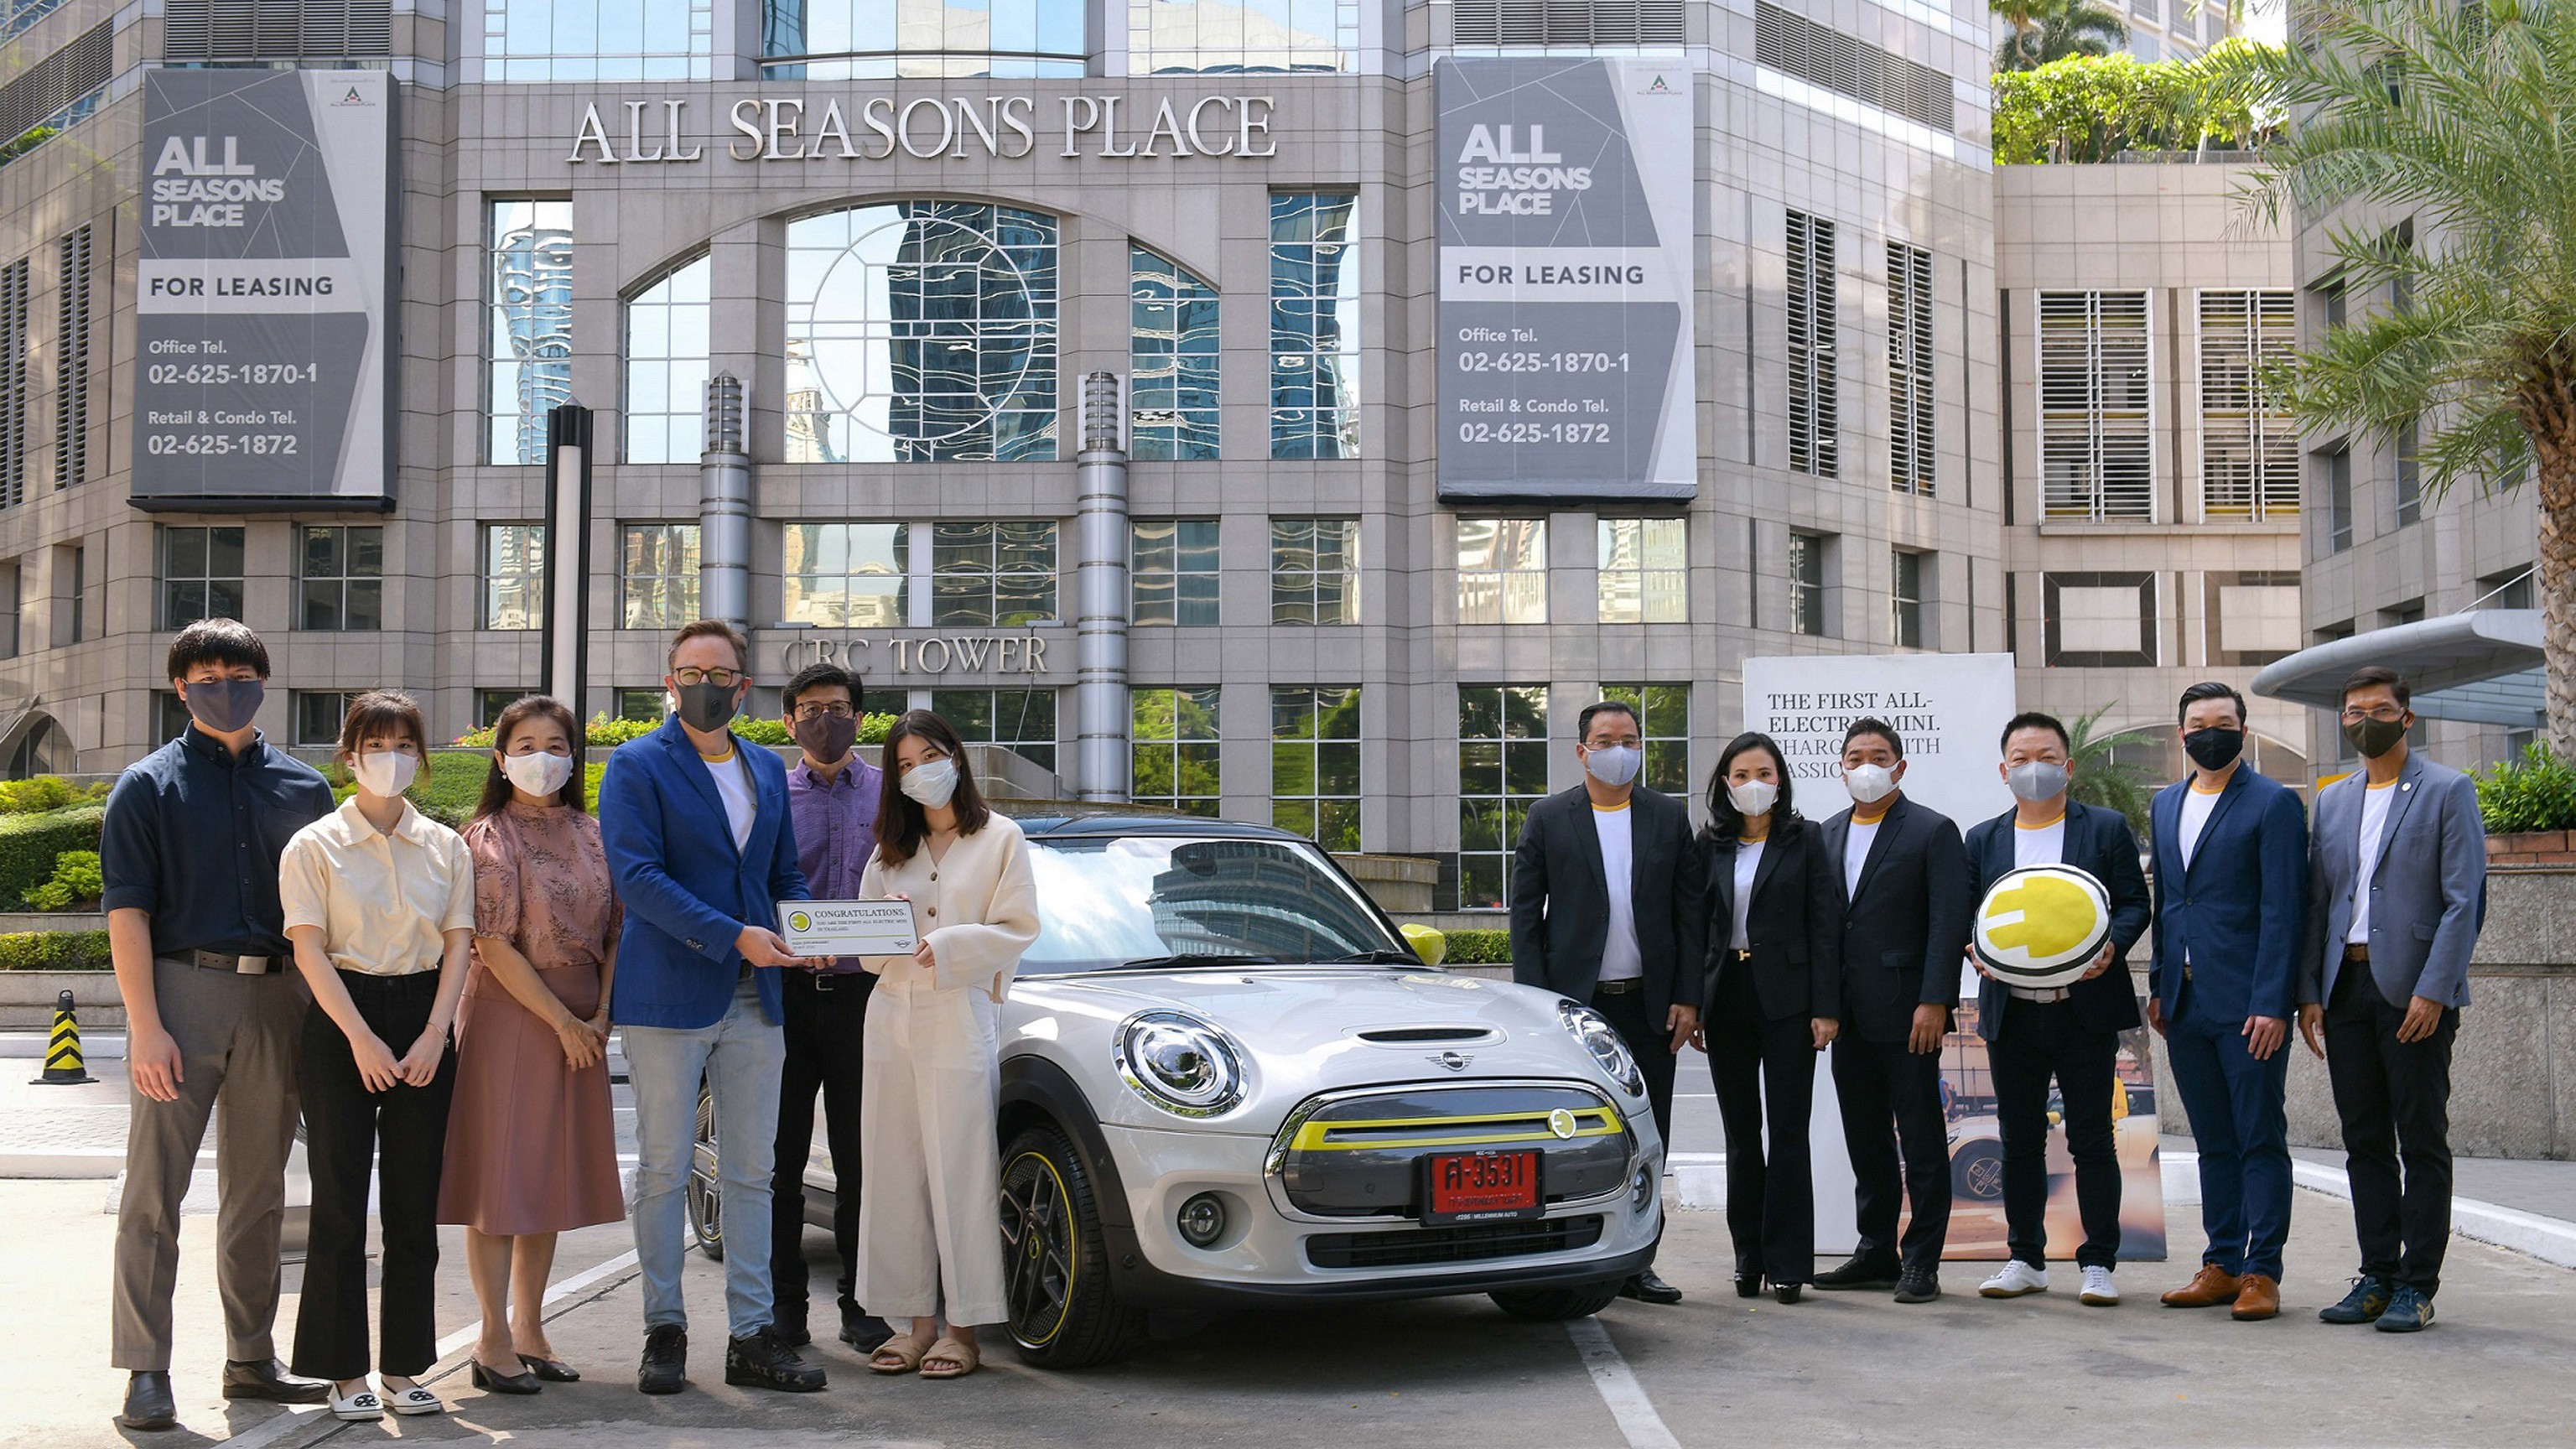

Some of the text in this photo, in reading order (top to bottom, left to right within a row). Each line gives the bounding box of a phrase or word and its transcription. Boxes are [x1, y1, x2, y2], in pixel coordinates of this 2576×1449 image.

[565, 96, 1276, 163] ALL SEASONS PLACE
[1458, 124, 1561, 164] ALL
[152, 136, 255, 175] ALL
[1458, 167, 1592, 190] SEASONS
[152, 179, 284, 202] SEASONS
[1459, 192, 1551, 216] PLACE
[153, 204, 244, 227] PLACE
[1459, 265, 1644, 284] FOR LEASING
[151, 276, 333, 296] FOR LEASING
[1458, 328, 1538, 342] Office Tel.
[148, 340, 227, 354] Office Tel.
[1459, 352, 1629, 372] 02-625-1870-1
[148, 362, 317, 384] 02-625-1870-1
[1459, 398, 1609, 413] Retail & Condo Tel.
[148, 410, 297, 424] Retail & Condo Tel.
[1459, 423, 1610, 443] 02-625-1872
[148, 434, 297, 454] 02-625-1872
[781, 636, 1047, 675] CRC TOWER
[1768, 692, 1934, 710] THE FIRST ALL-
[1883, 714, 1940, 731] MINI.
[1905, 737, 1940, 754] ITH
[814, 908, 906, 918] CONGRATULATIONS.
